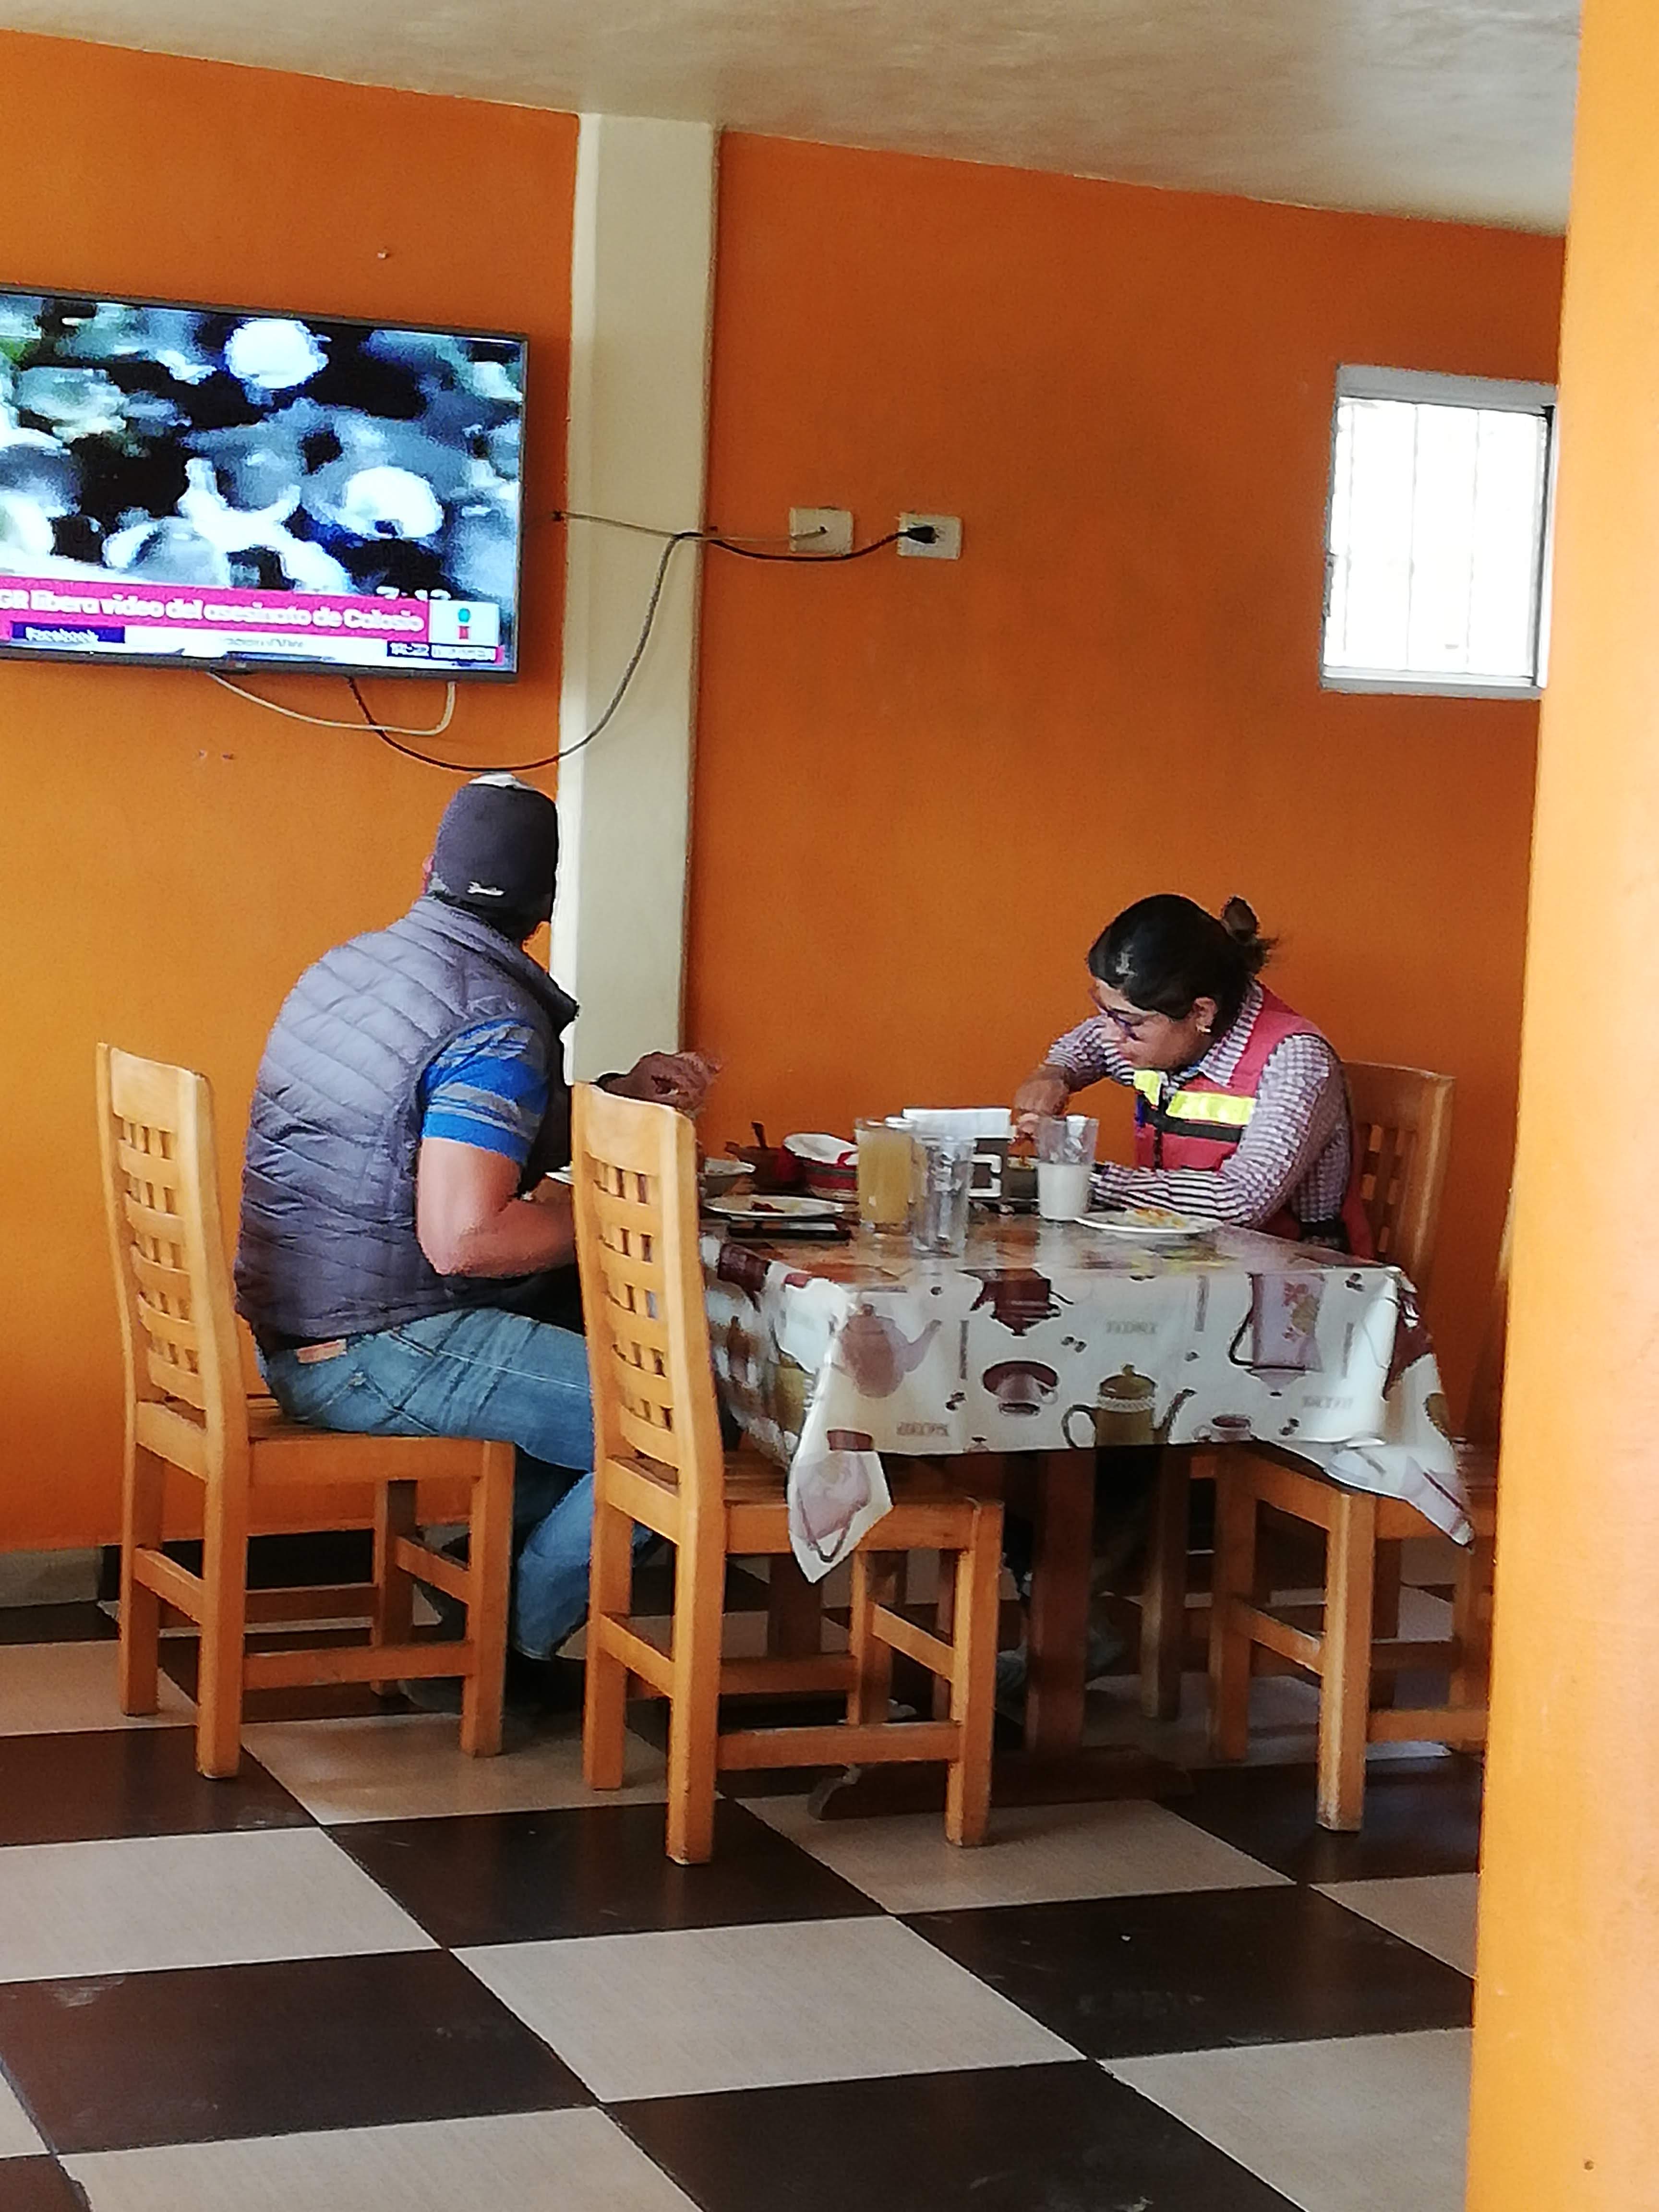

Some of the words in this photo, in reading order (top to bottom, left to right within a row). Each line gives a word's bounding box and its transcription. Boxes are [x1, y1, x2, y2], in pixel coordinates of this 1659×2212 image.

[30, 590, 99, 613] libera
[100, 594, 164, 617] video
[166, 599, 203, 620] del
[204, 602, 312, 625] asesinato
[313, 607, 342, 627] de
[343, 609, 424, 631] Colosio
